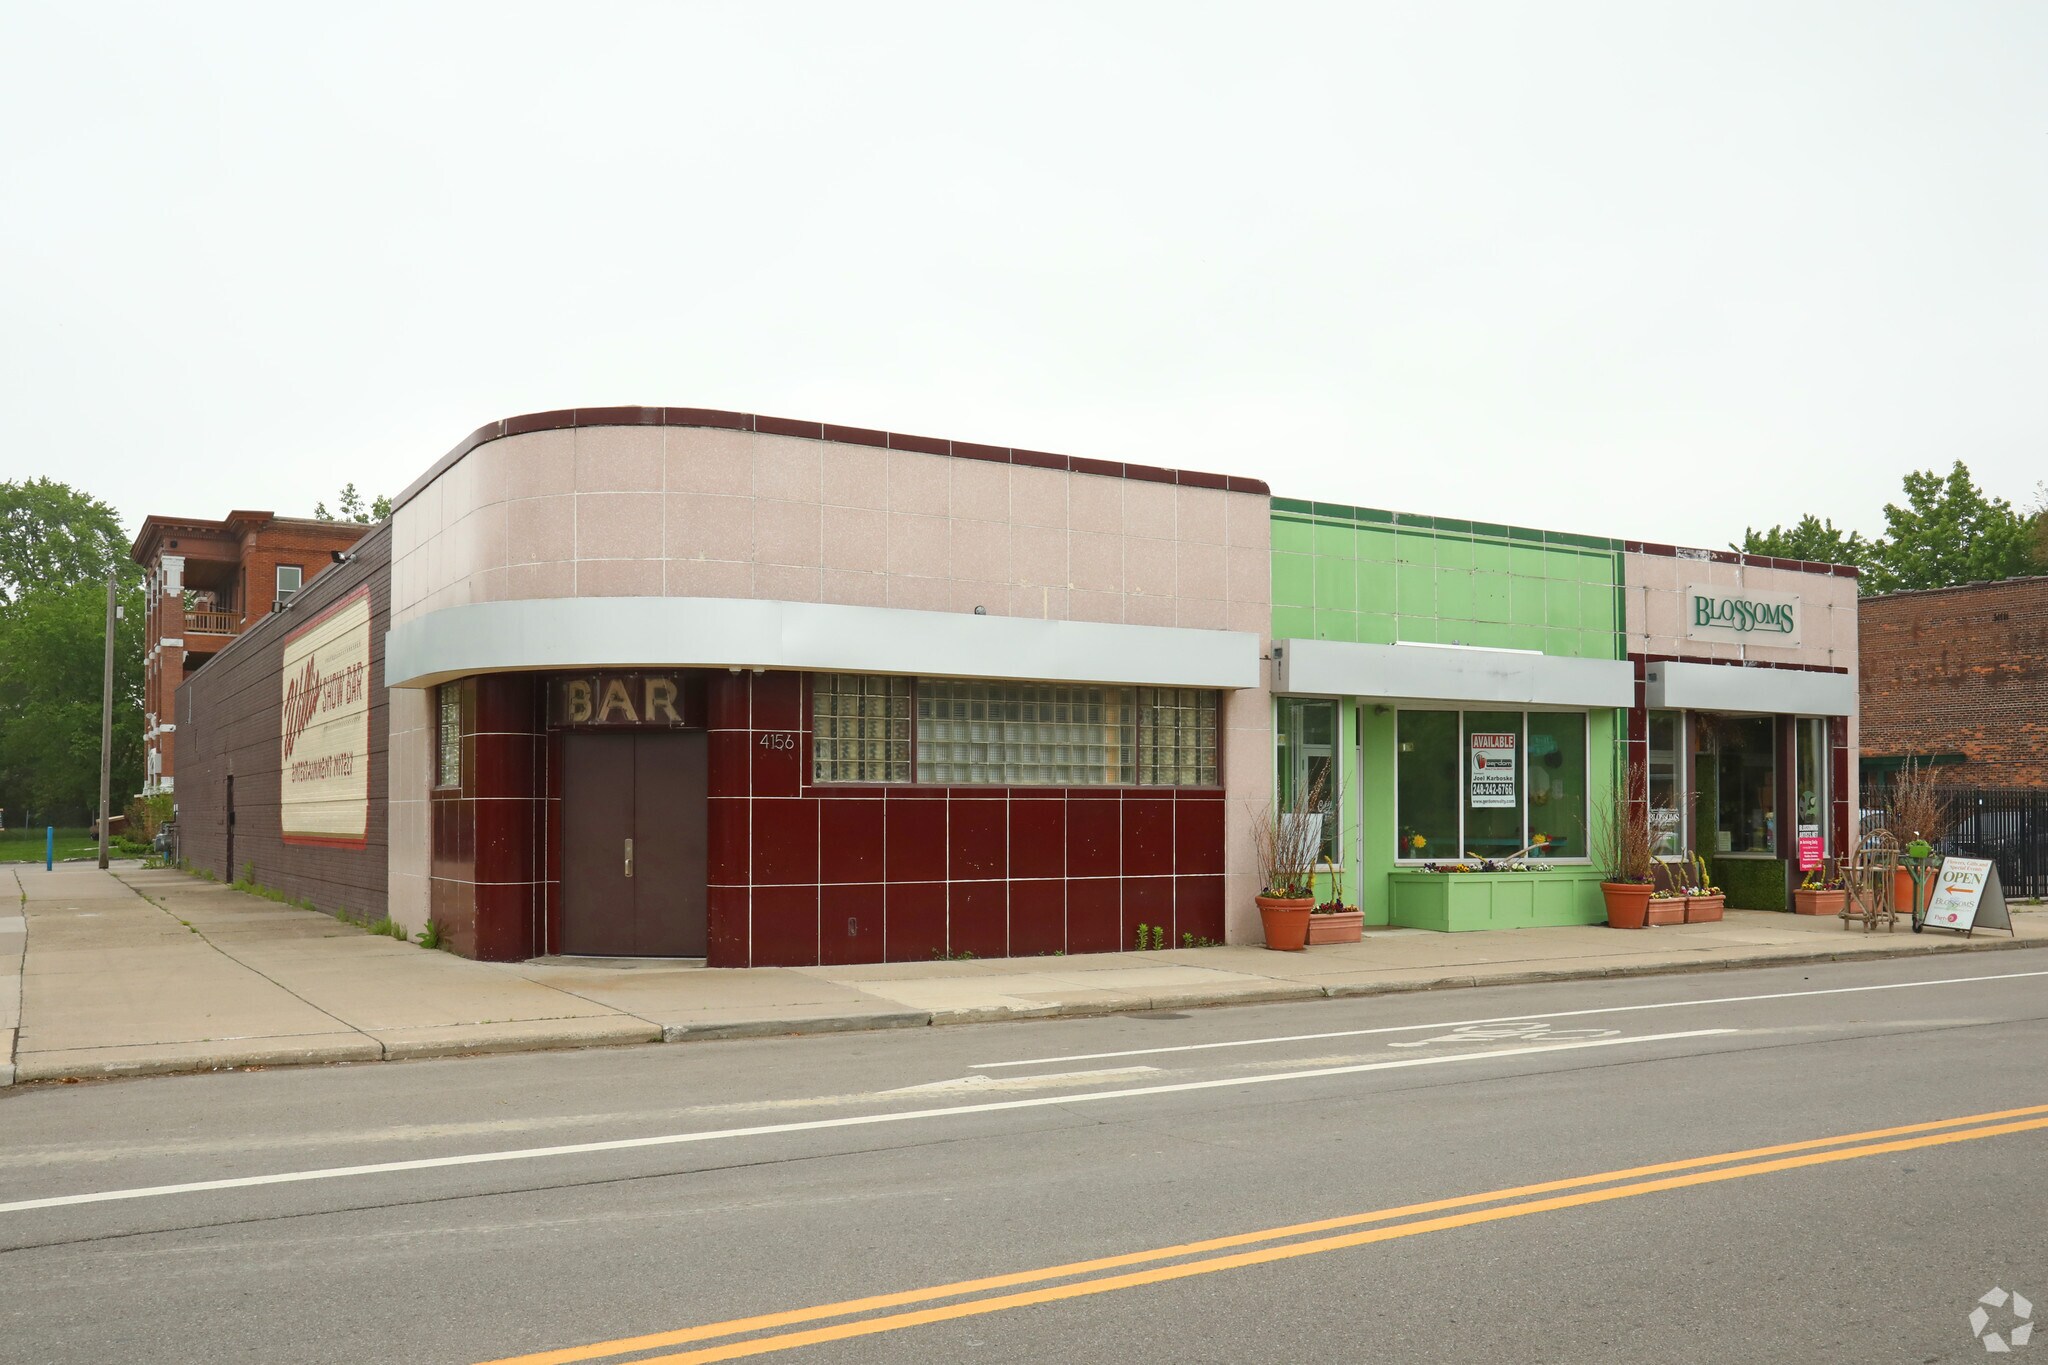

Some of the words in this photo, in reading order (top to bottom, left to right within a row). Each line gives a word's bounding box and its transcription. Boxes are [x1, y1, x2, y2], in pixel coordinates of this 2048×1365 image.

[1694, 595, 1794, 634] BLOSSOMS
[322, 669, 346, 713] SHOW
[346, 661, 364, 705] BAR
[568, 678, 684, 723] BAR
[759, 733, 795, 750] 4156
[1473, 736, 1513, 748] AVAILABLE
[291, 754, 333, 783] ENTERTAINMENT
[333, 750, 354, 778] NITELY
[1473, 784, 1512, 795] 248-242-6766
[1943, 871, 1982, 884] OPEN
